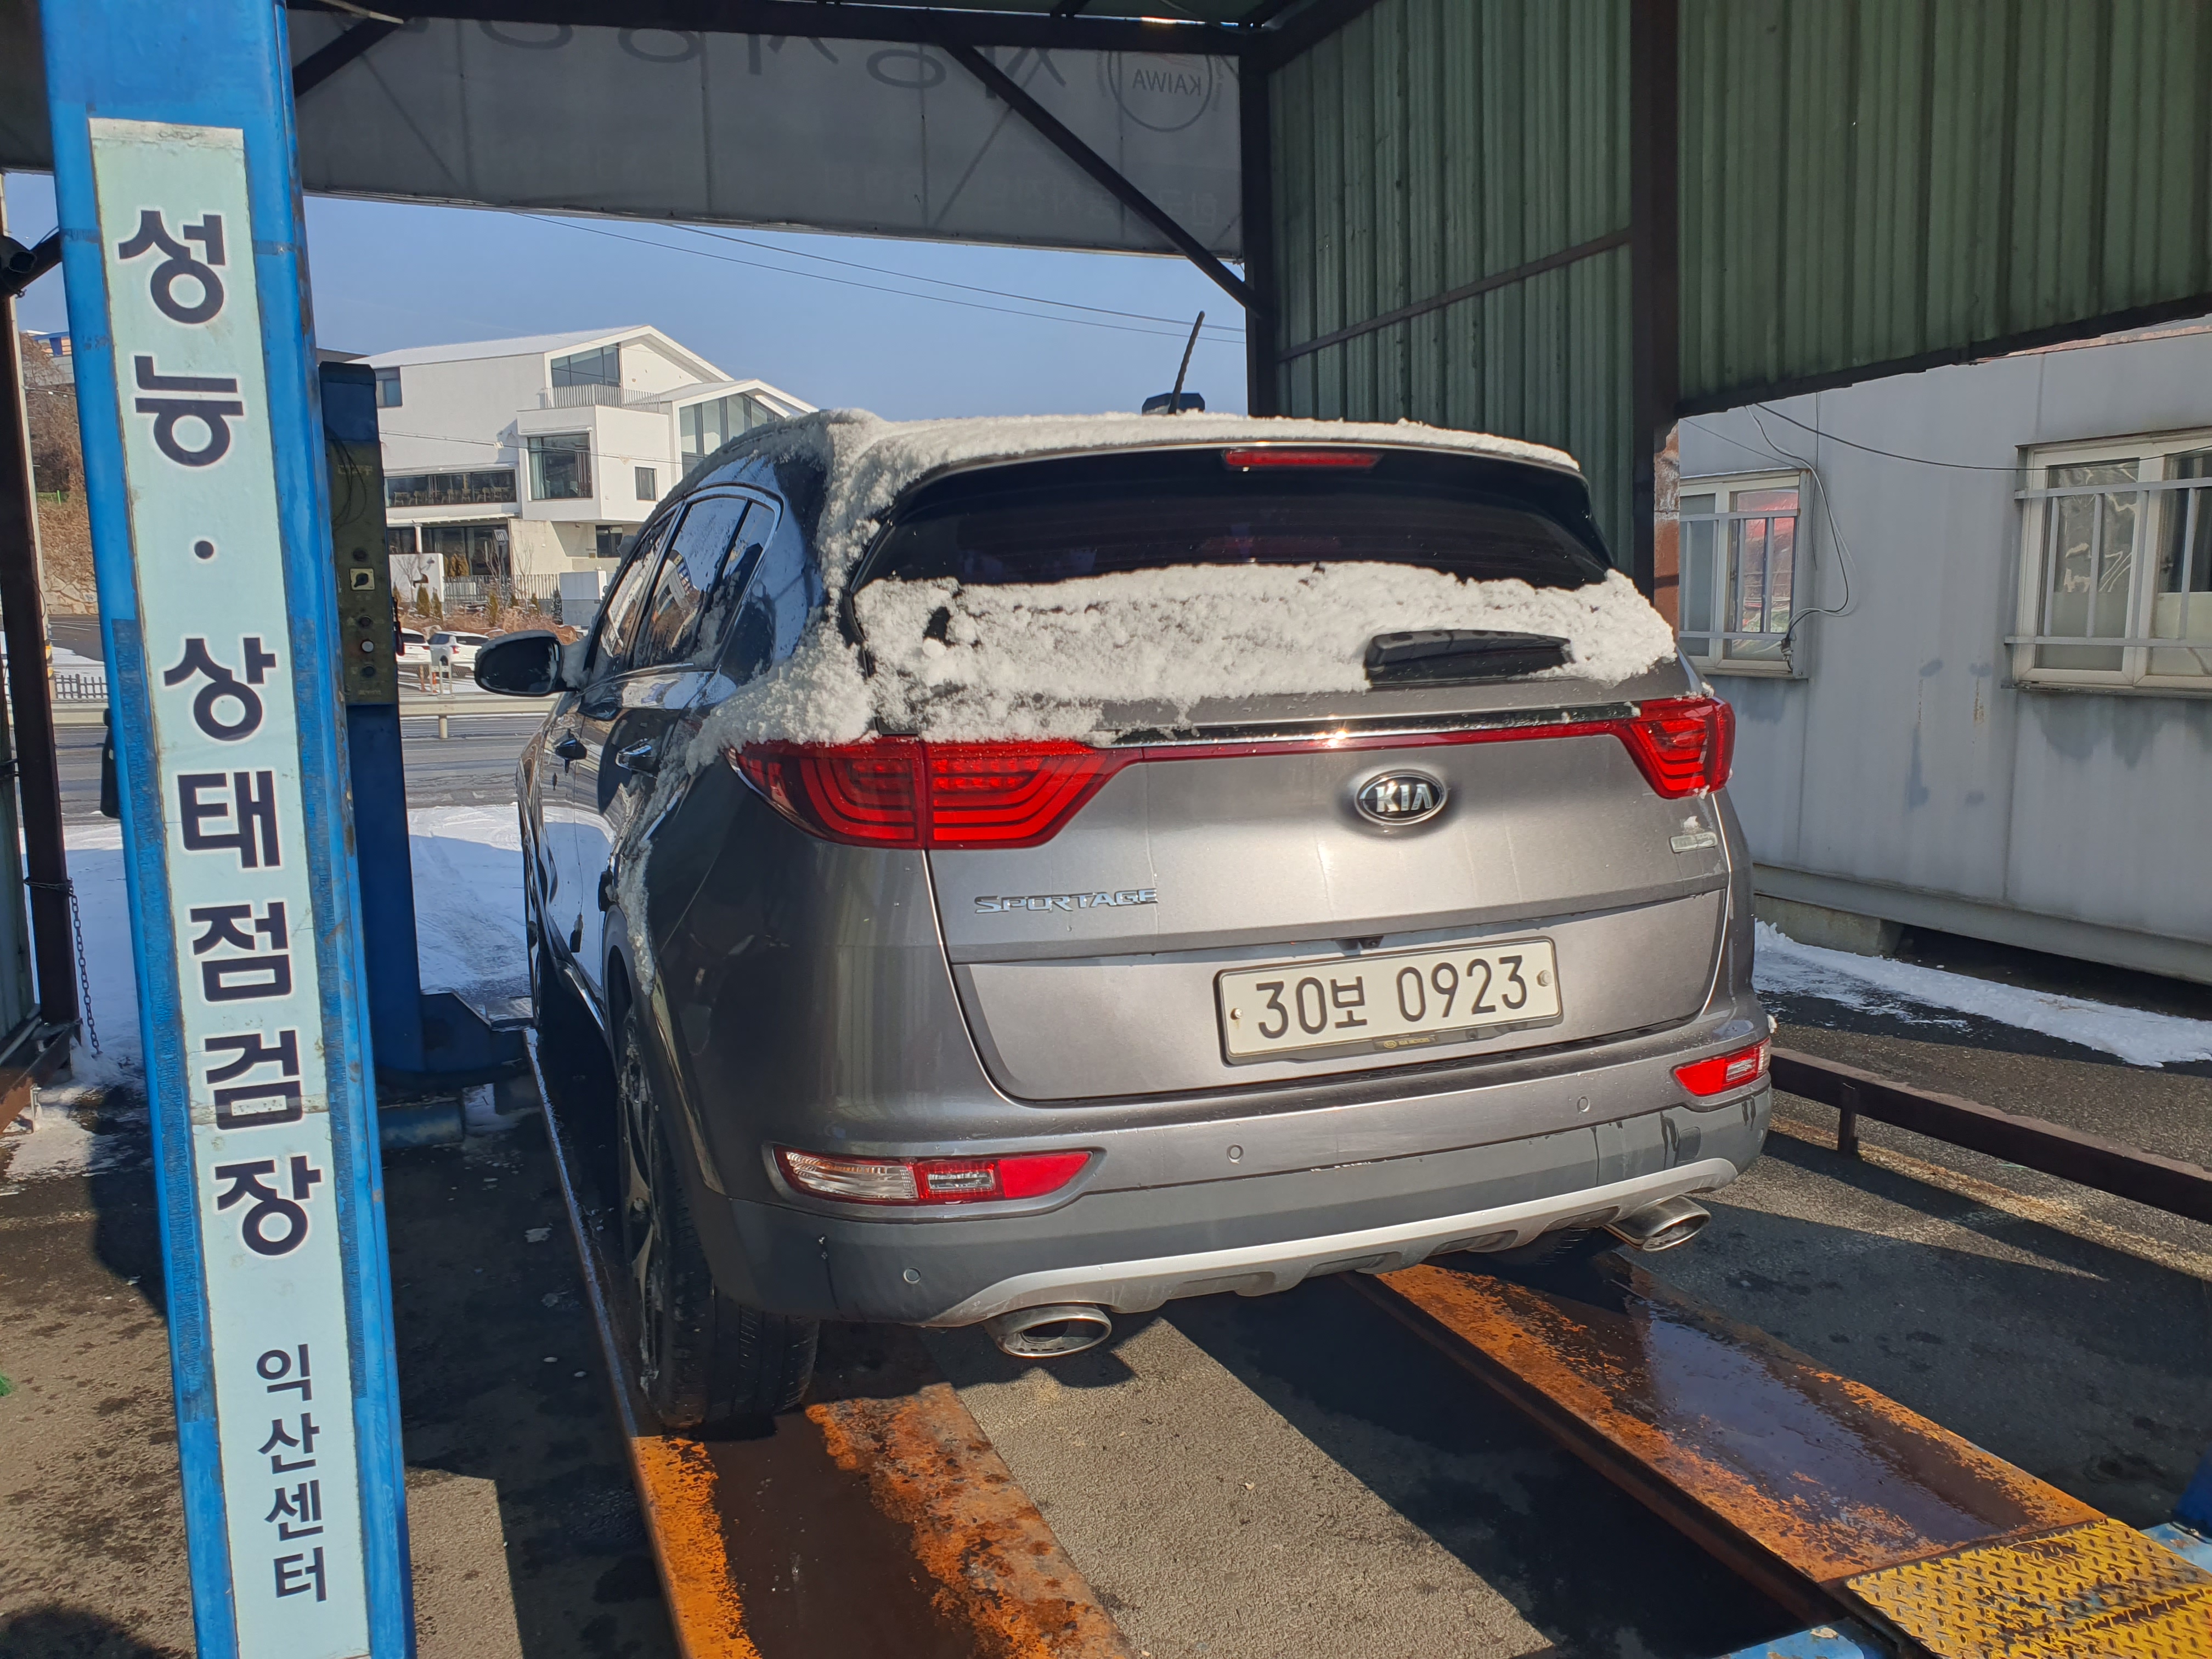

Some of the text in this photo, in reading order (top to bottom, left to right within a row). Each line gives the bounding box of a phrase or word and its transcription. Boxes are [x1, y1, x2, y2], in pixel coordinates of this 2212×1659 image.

[1375, 781, 1434, 812] KIA
[974, 888, 1159, 914] SPORTAGE
[1255, 955, 1528, 1039] 30보 0923
[256, 1342, 328, 1602] 익산센터
